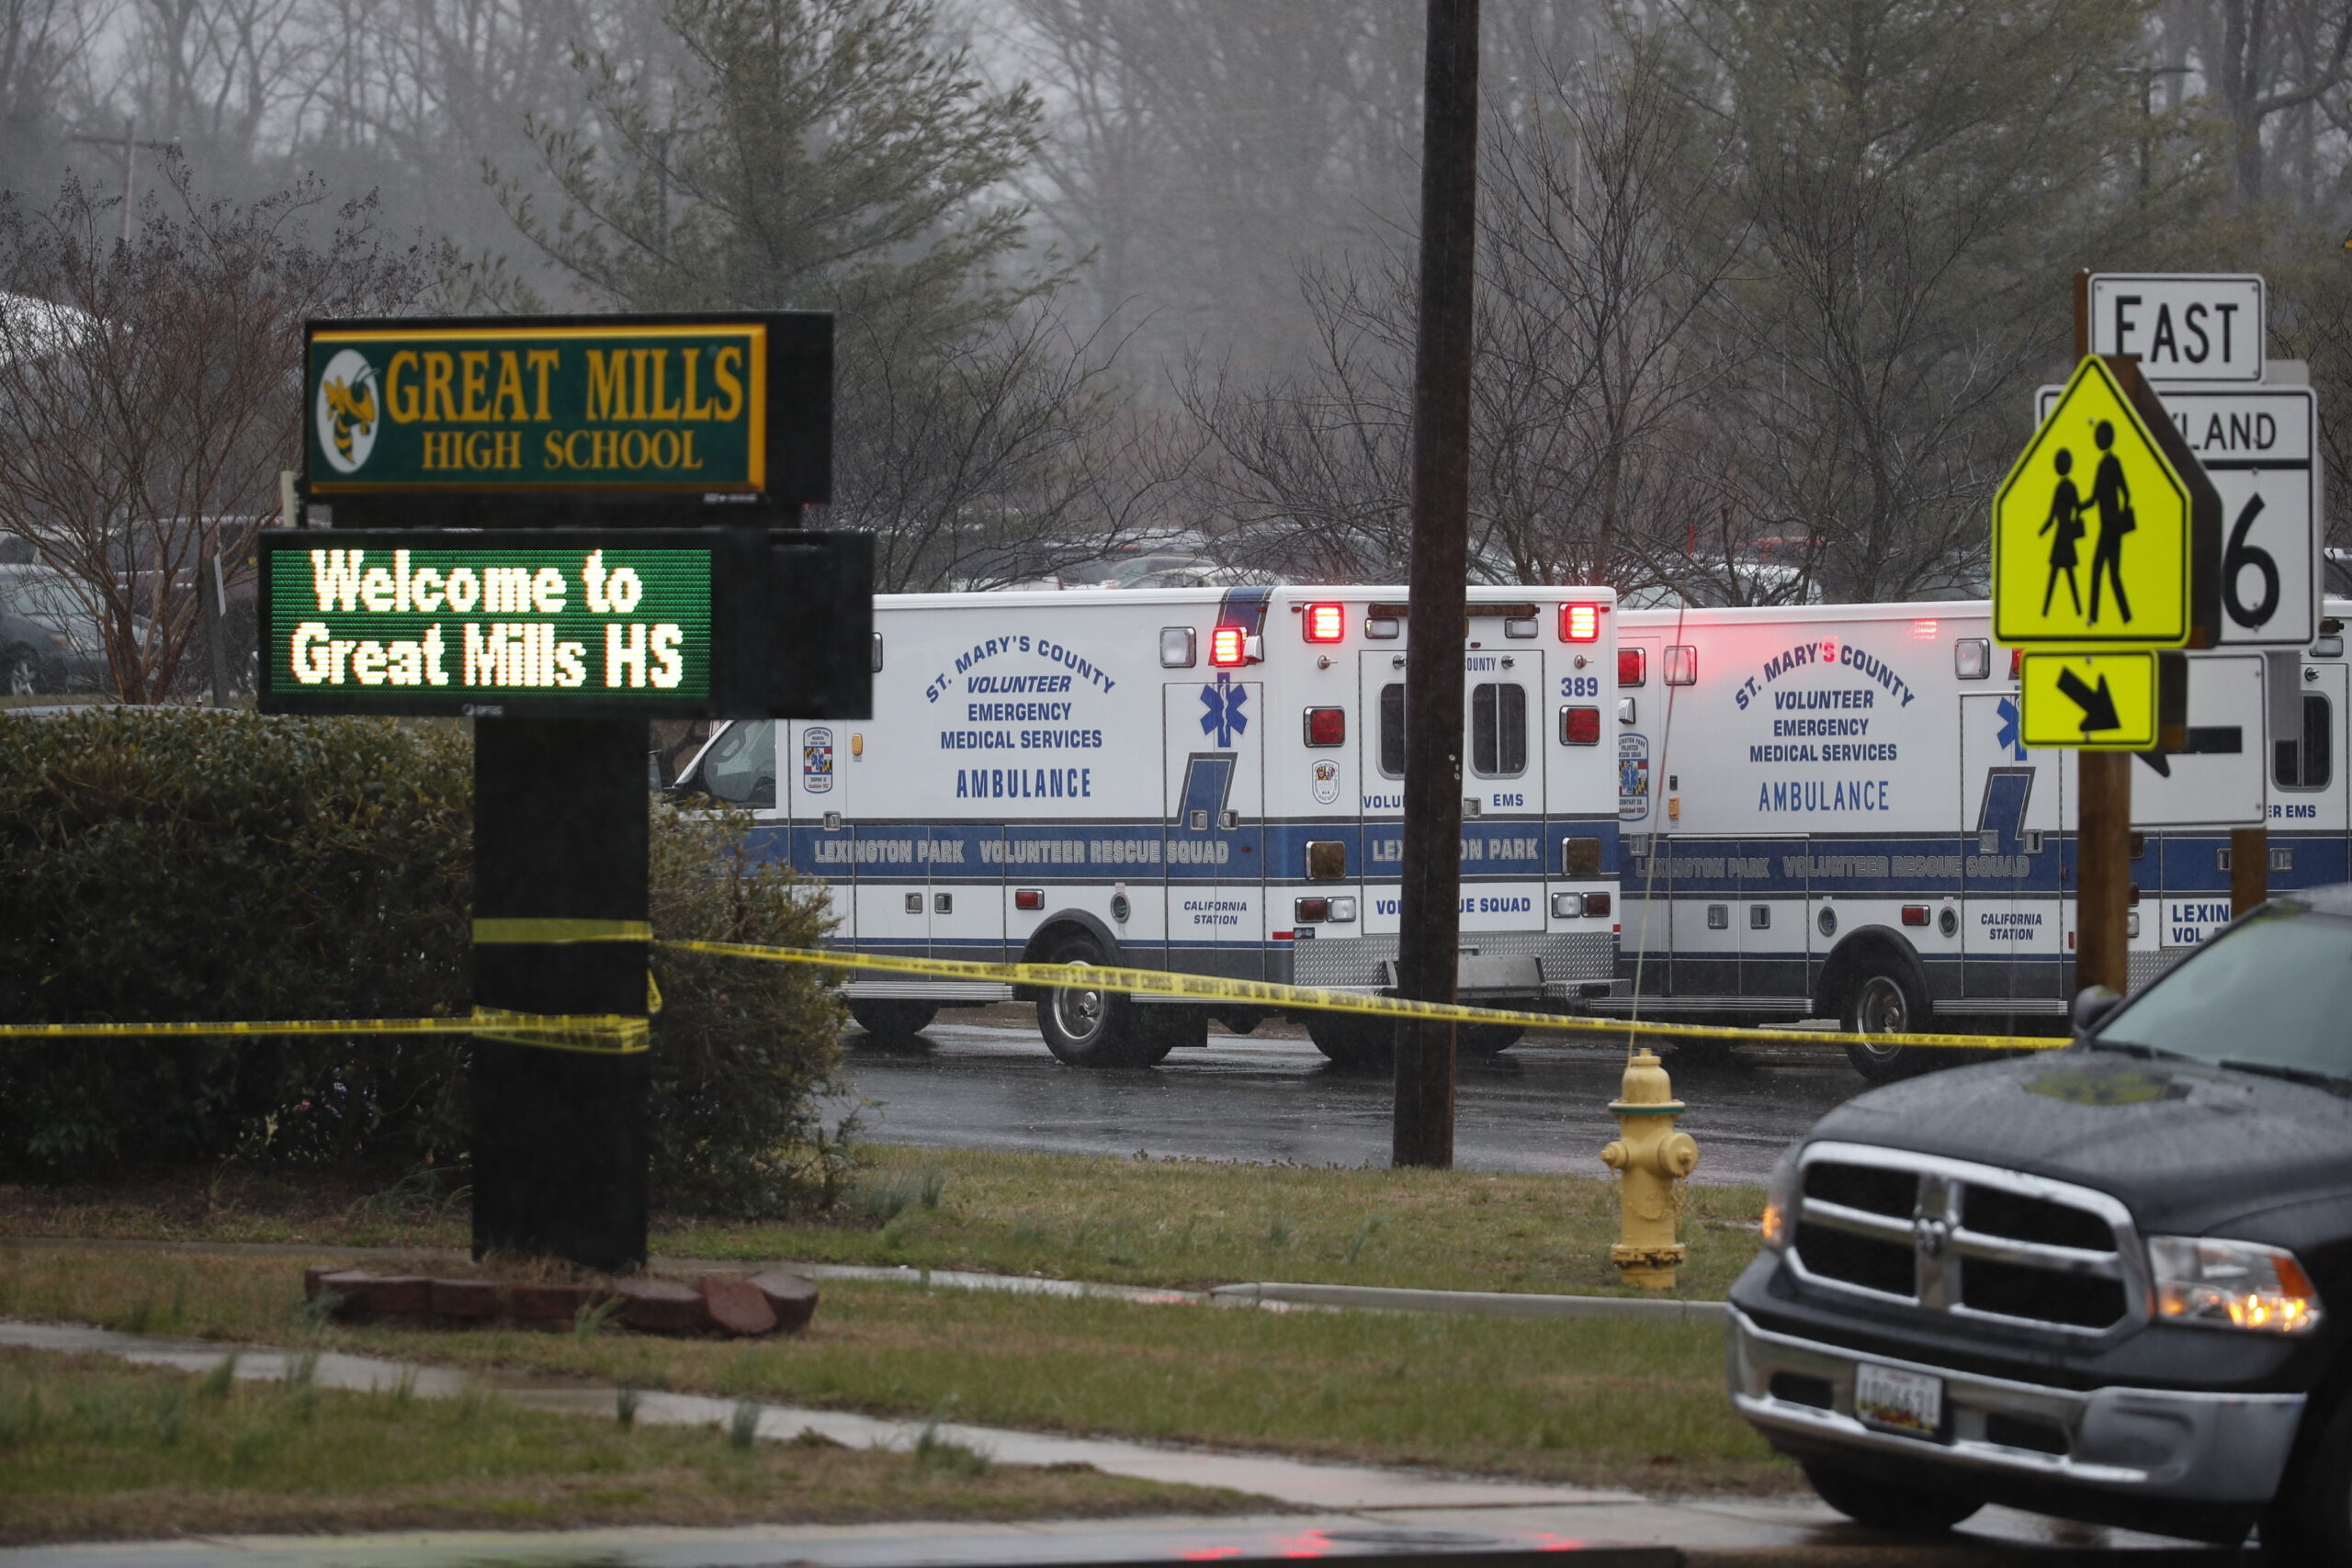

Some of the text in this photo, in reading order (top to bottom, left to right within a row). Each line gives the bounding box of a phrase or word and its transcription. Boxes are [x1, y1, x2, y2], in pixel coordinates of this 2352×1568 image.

[2116, 295, 2238, 364] EAST
[386, 345, 743, 423] GREAT MILLS
[2172, 412, 2277, 450] LAND
[422, 429, 703, 470] HIGH SCHOOL
[2222, 492, 2280, 629] 6
[311, 548, 643, 613] Welcome to
[291, 622, 684, 688] Great Mills HS
[925, 635, 1115, 705] ST. MARY'S COUNTY
[1735, 642, 1916, 711] ST. MARY'S COUNTY
[967, 675, 1071, 694] VOLUNTEER
[1561, 677, 1599, 697] 389
[1774, 690, 1874, 709] VOLUNTEER
[967, 703, 1071, 721] EMERGENCY
[1773, 718, 1869, 737] EMERGENCY
[941, 729, 1102, 750] MEDICAL SERVICES
[1749, 743, 1897, 763] MEDICAL SERVICES
[956, 768, 1091, 798] AMBULANCE
[1363, 794, 1523, 808] VOLU EMS
[1758, 781, 1889, 812] AMBULANCE
[2286, 805, 2316, 818] EMS
[815, 839, 1228, 863] LEXINGTON PARK VOLUNTEER RESCUE SQUAD
[1489, 838, 1539, 861] PARK
[1635, 855, 2030, 878] LEXINGTON PARK VOLUNTEER RESCUE SQUAD
[1183, 900, 1248, 912] CALIFORNIA
[1480, 897, 1531, 912] SQUAD
[2172, 904, 2230, 923] LEXIN
[1193, 914, 1238, 926] STATION
[1981, 913, 2042, 925] CALIFORNIA
[1989, 928, 2034, 941] STATION
